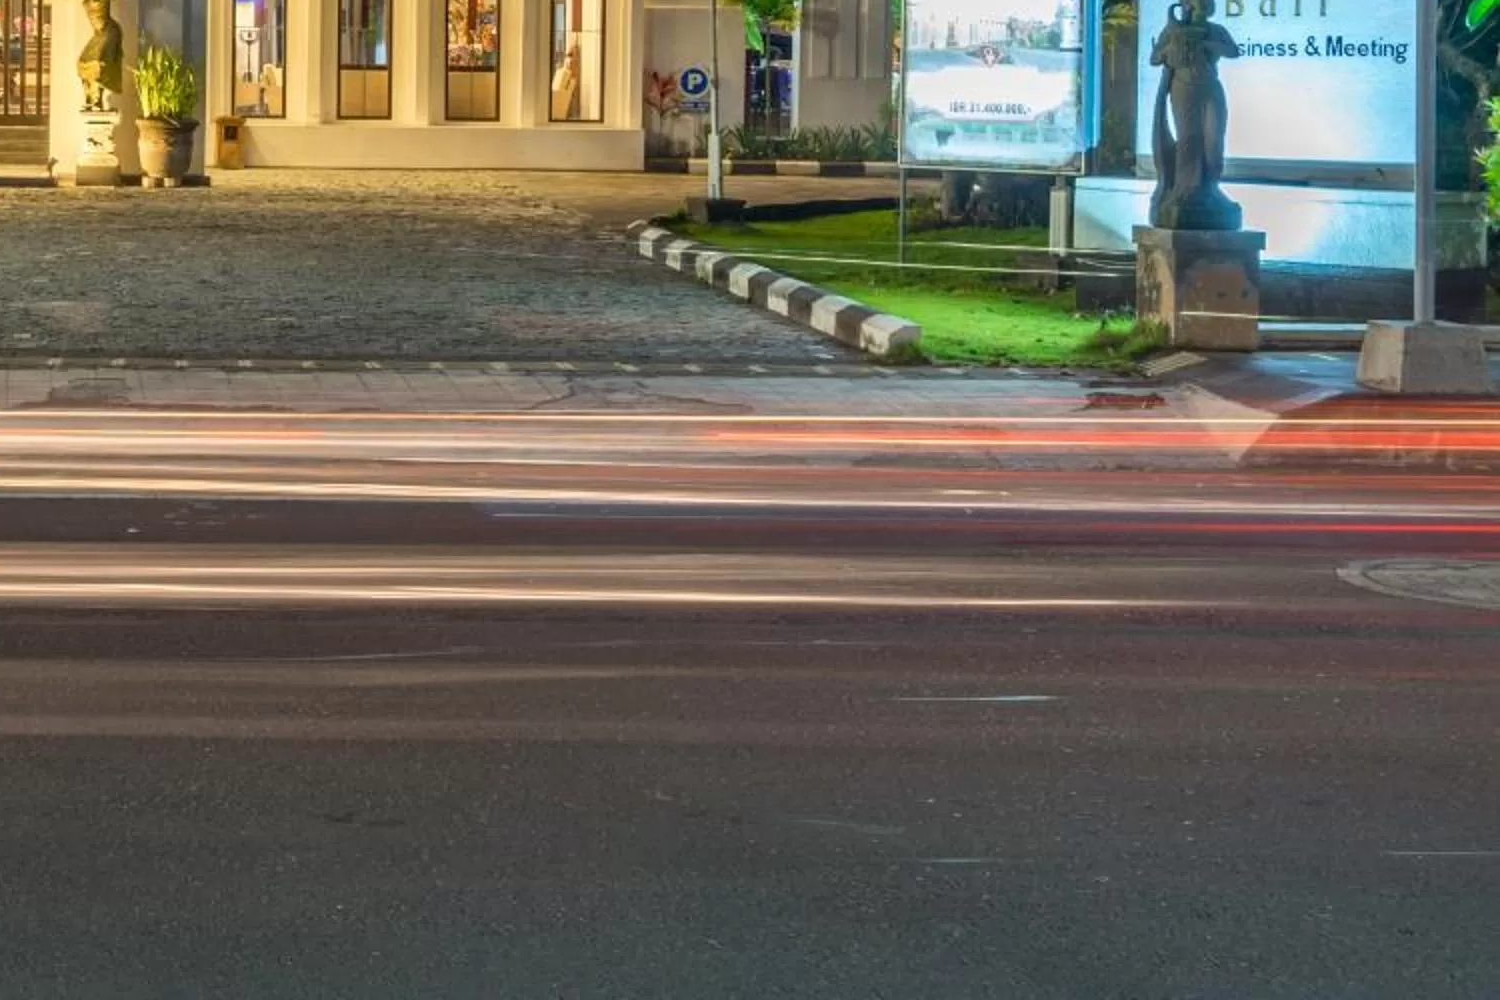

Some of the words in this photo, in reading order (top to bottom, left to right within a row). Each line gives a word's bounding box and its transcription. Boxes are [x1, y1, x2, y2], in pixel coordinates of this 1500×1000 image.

[1236, 37, 1298, 57] siness
[1304, 35, 1321, 57] &
[1325, 34, 1409, 65] Meeting
[687, 72, 704, 91] P
